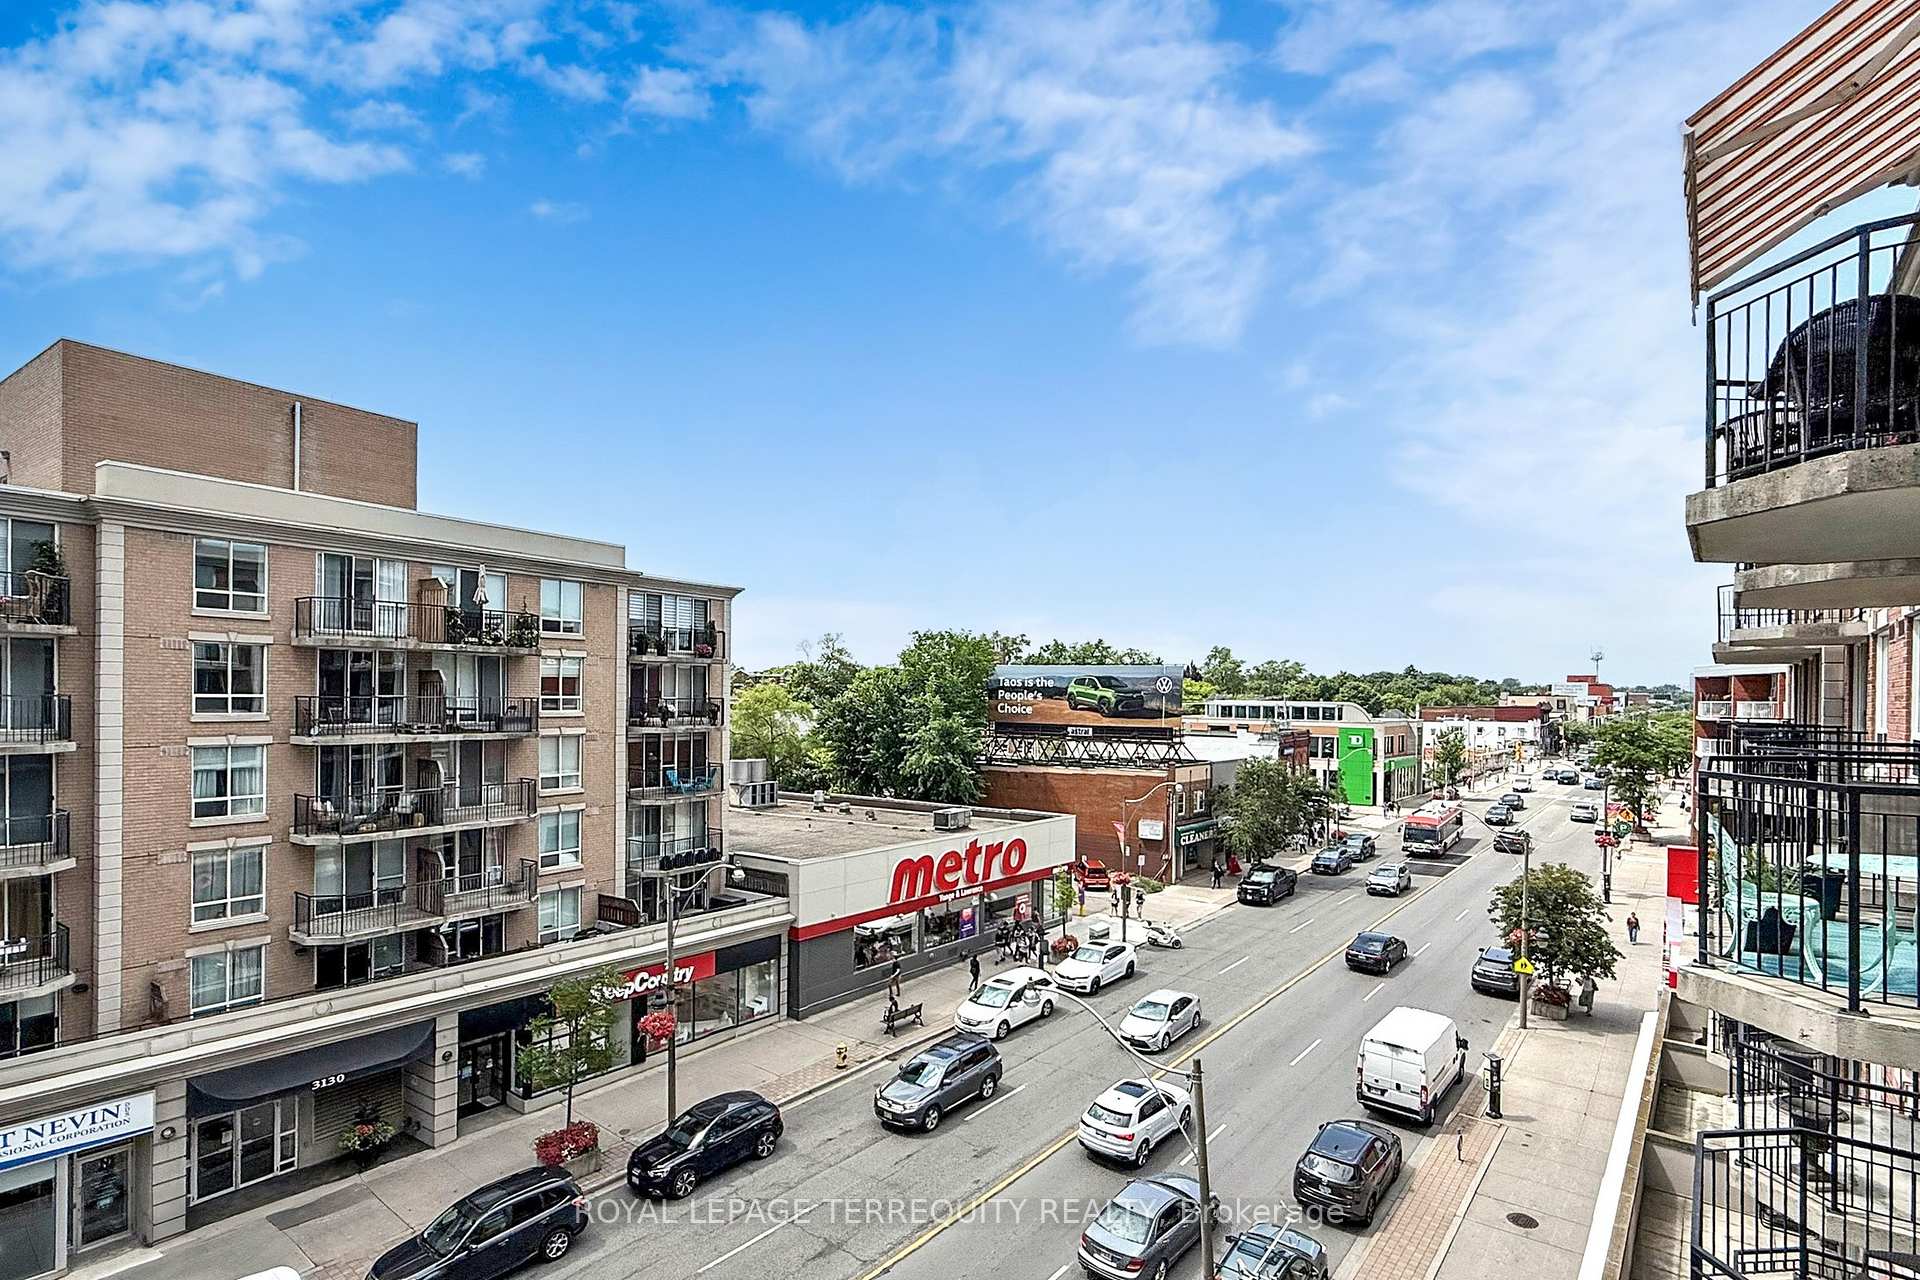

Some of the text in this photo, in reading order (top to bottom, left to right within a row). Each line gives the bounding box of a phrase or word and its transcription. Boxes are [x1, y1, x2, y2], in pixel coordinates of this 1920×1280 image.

[998, 677, 1054, 687] Taos is the
[998, 690, 1043, 701] People's
[997, 703, 1033, 714] Choice
[890, 838, 1027, 904] metro
[311, 1073, 345, 1091] 3130
[24, 1104, 122, 1143] NEVIN
[50, 1117, 131, 1144] CORPORATION
